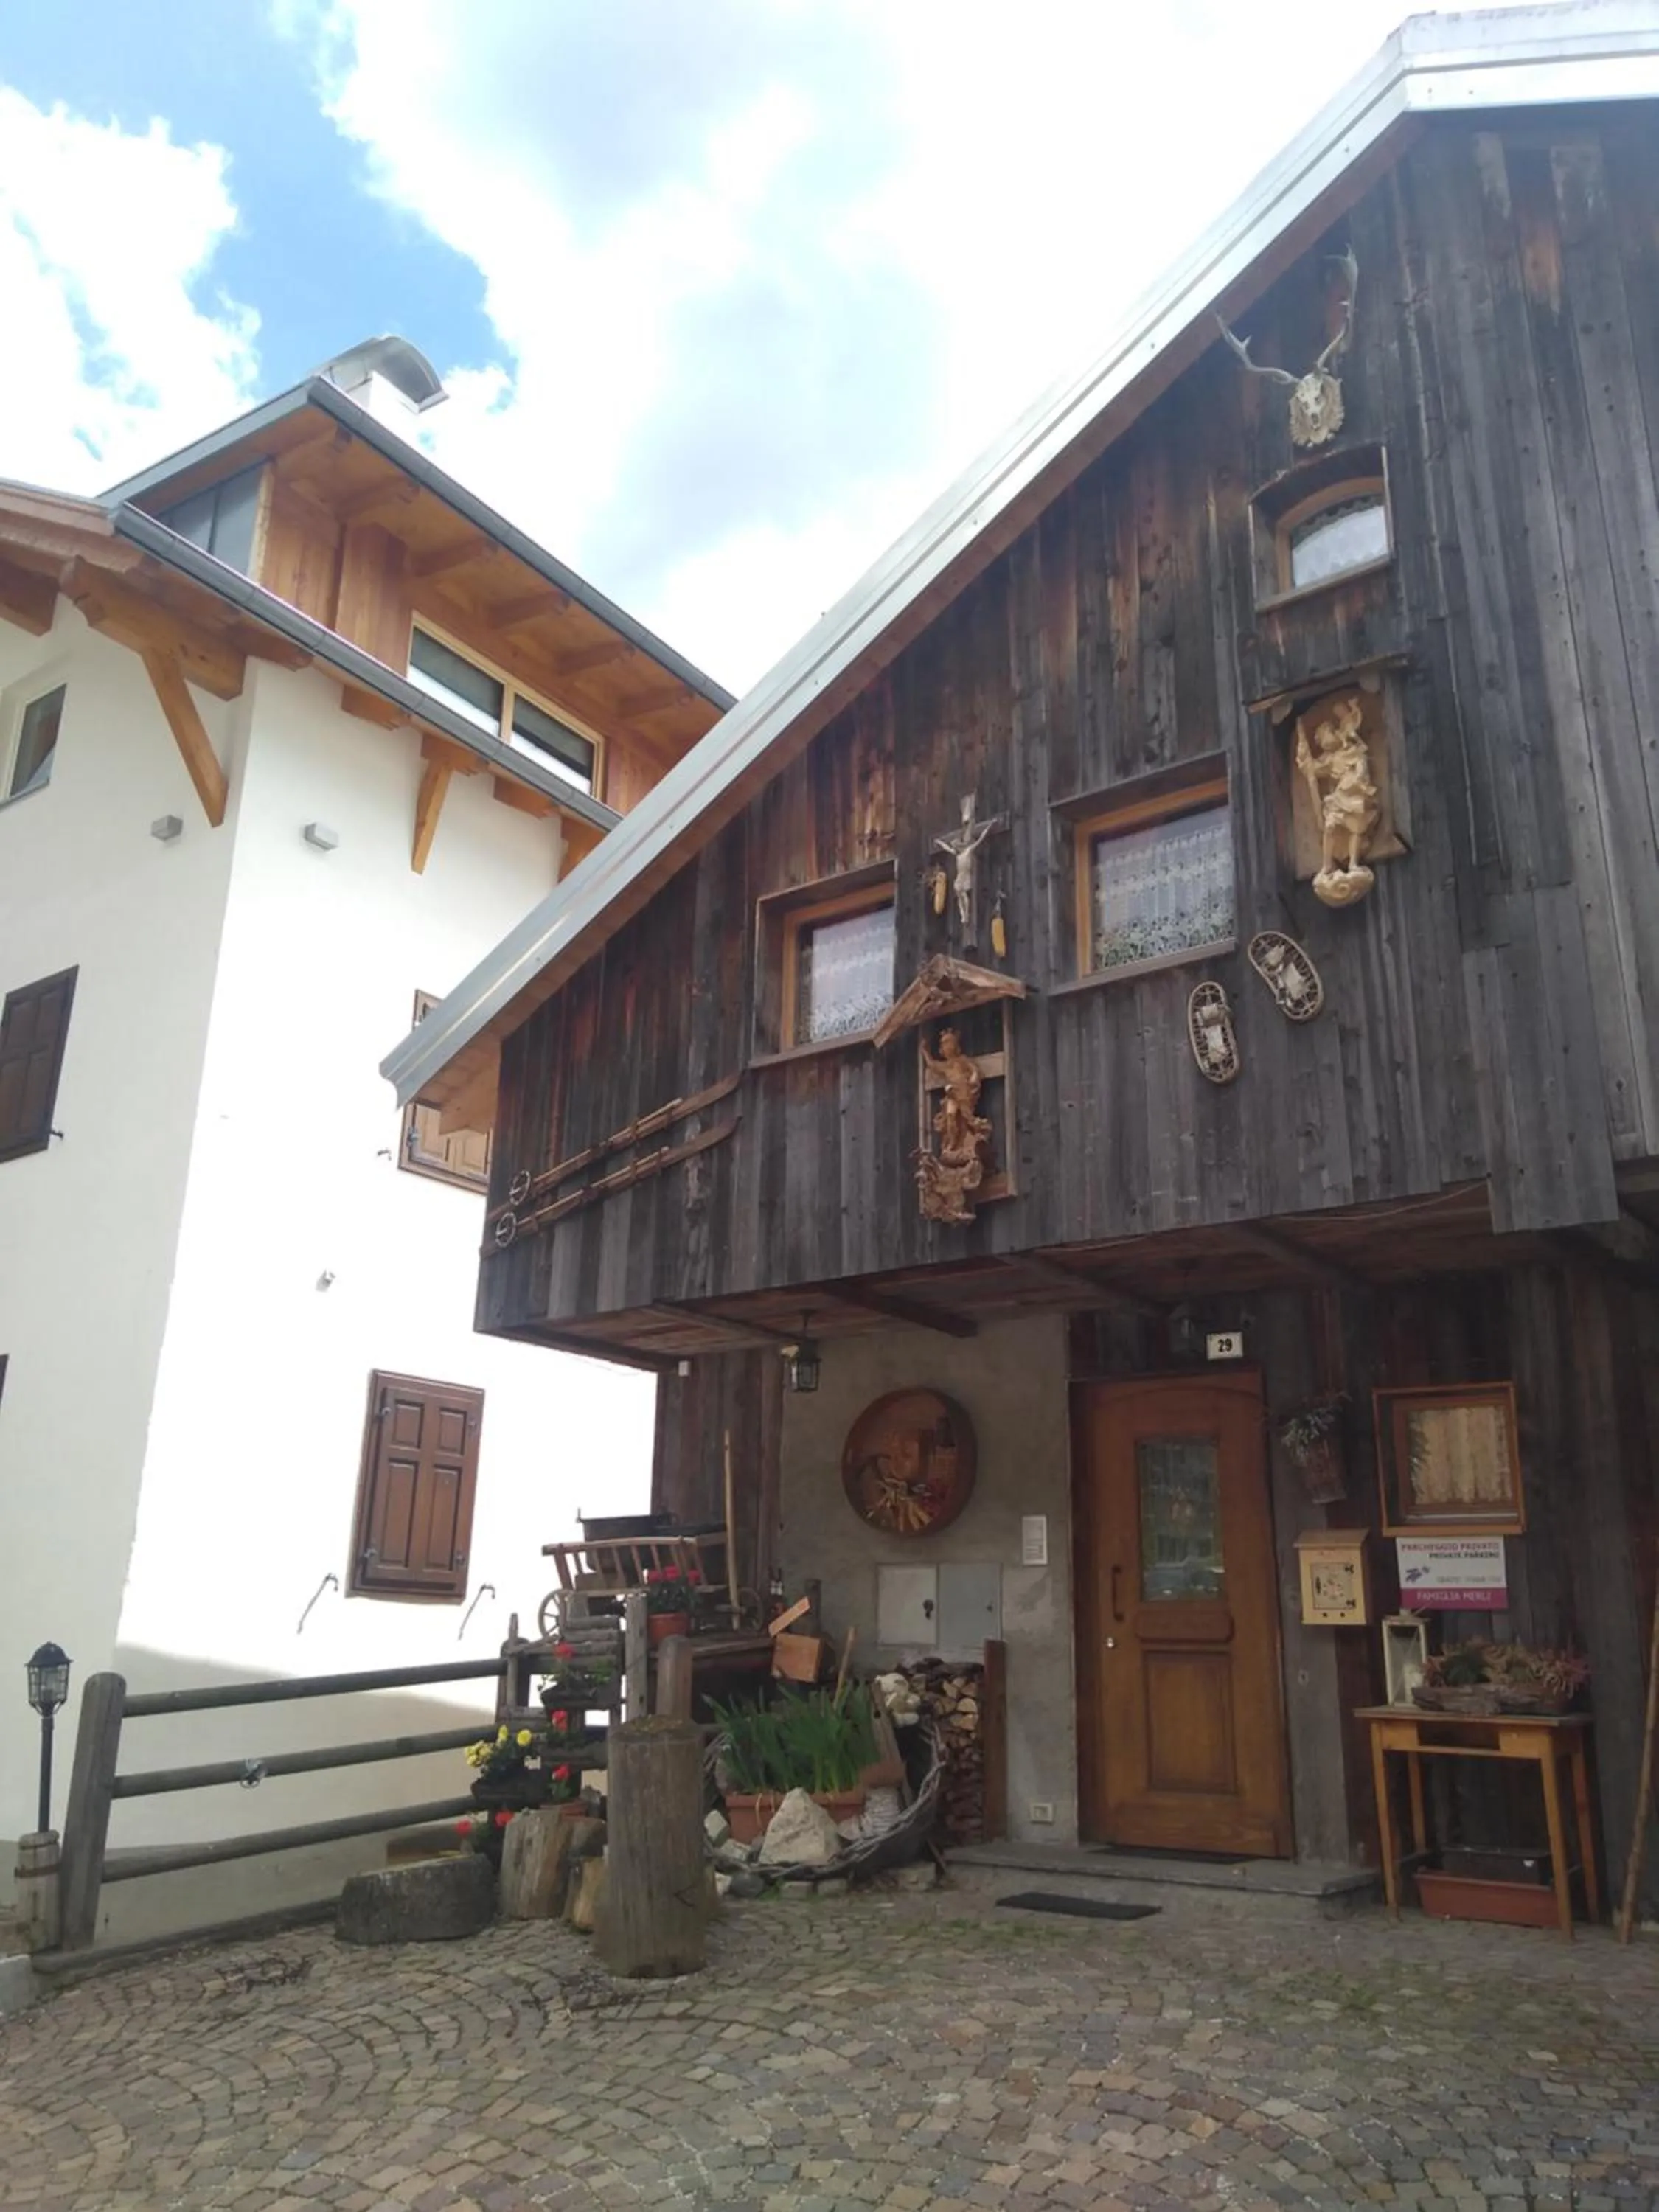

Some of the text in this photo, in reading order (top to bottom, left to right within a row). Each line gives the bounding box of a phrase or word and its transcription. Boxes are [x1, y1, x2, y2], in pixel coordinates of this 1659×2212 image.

[1218, 1338, 1233, 1352] 29
[1460, 1542, 1500, 1550] PRIVATO
[1416, 1592, 1461, 1601] FAMIGLIA
